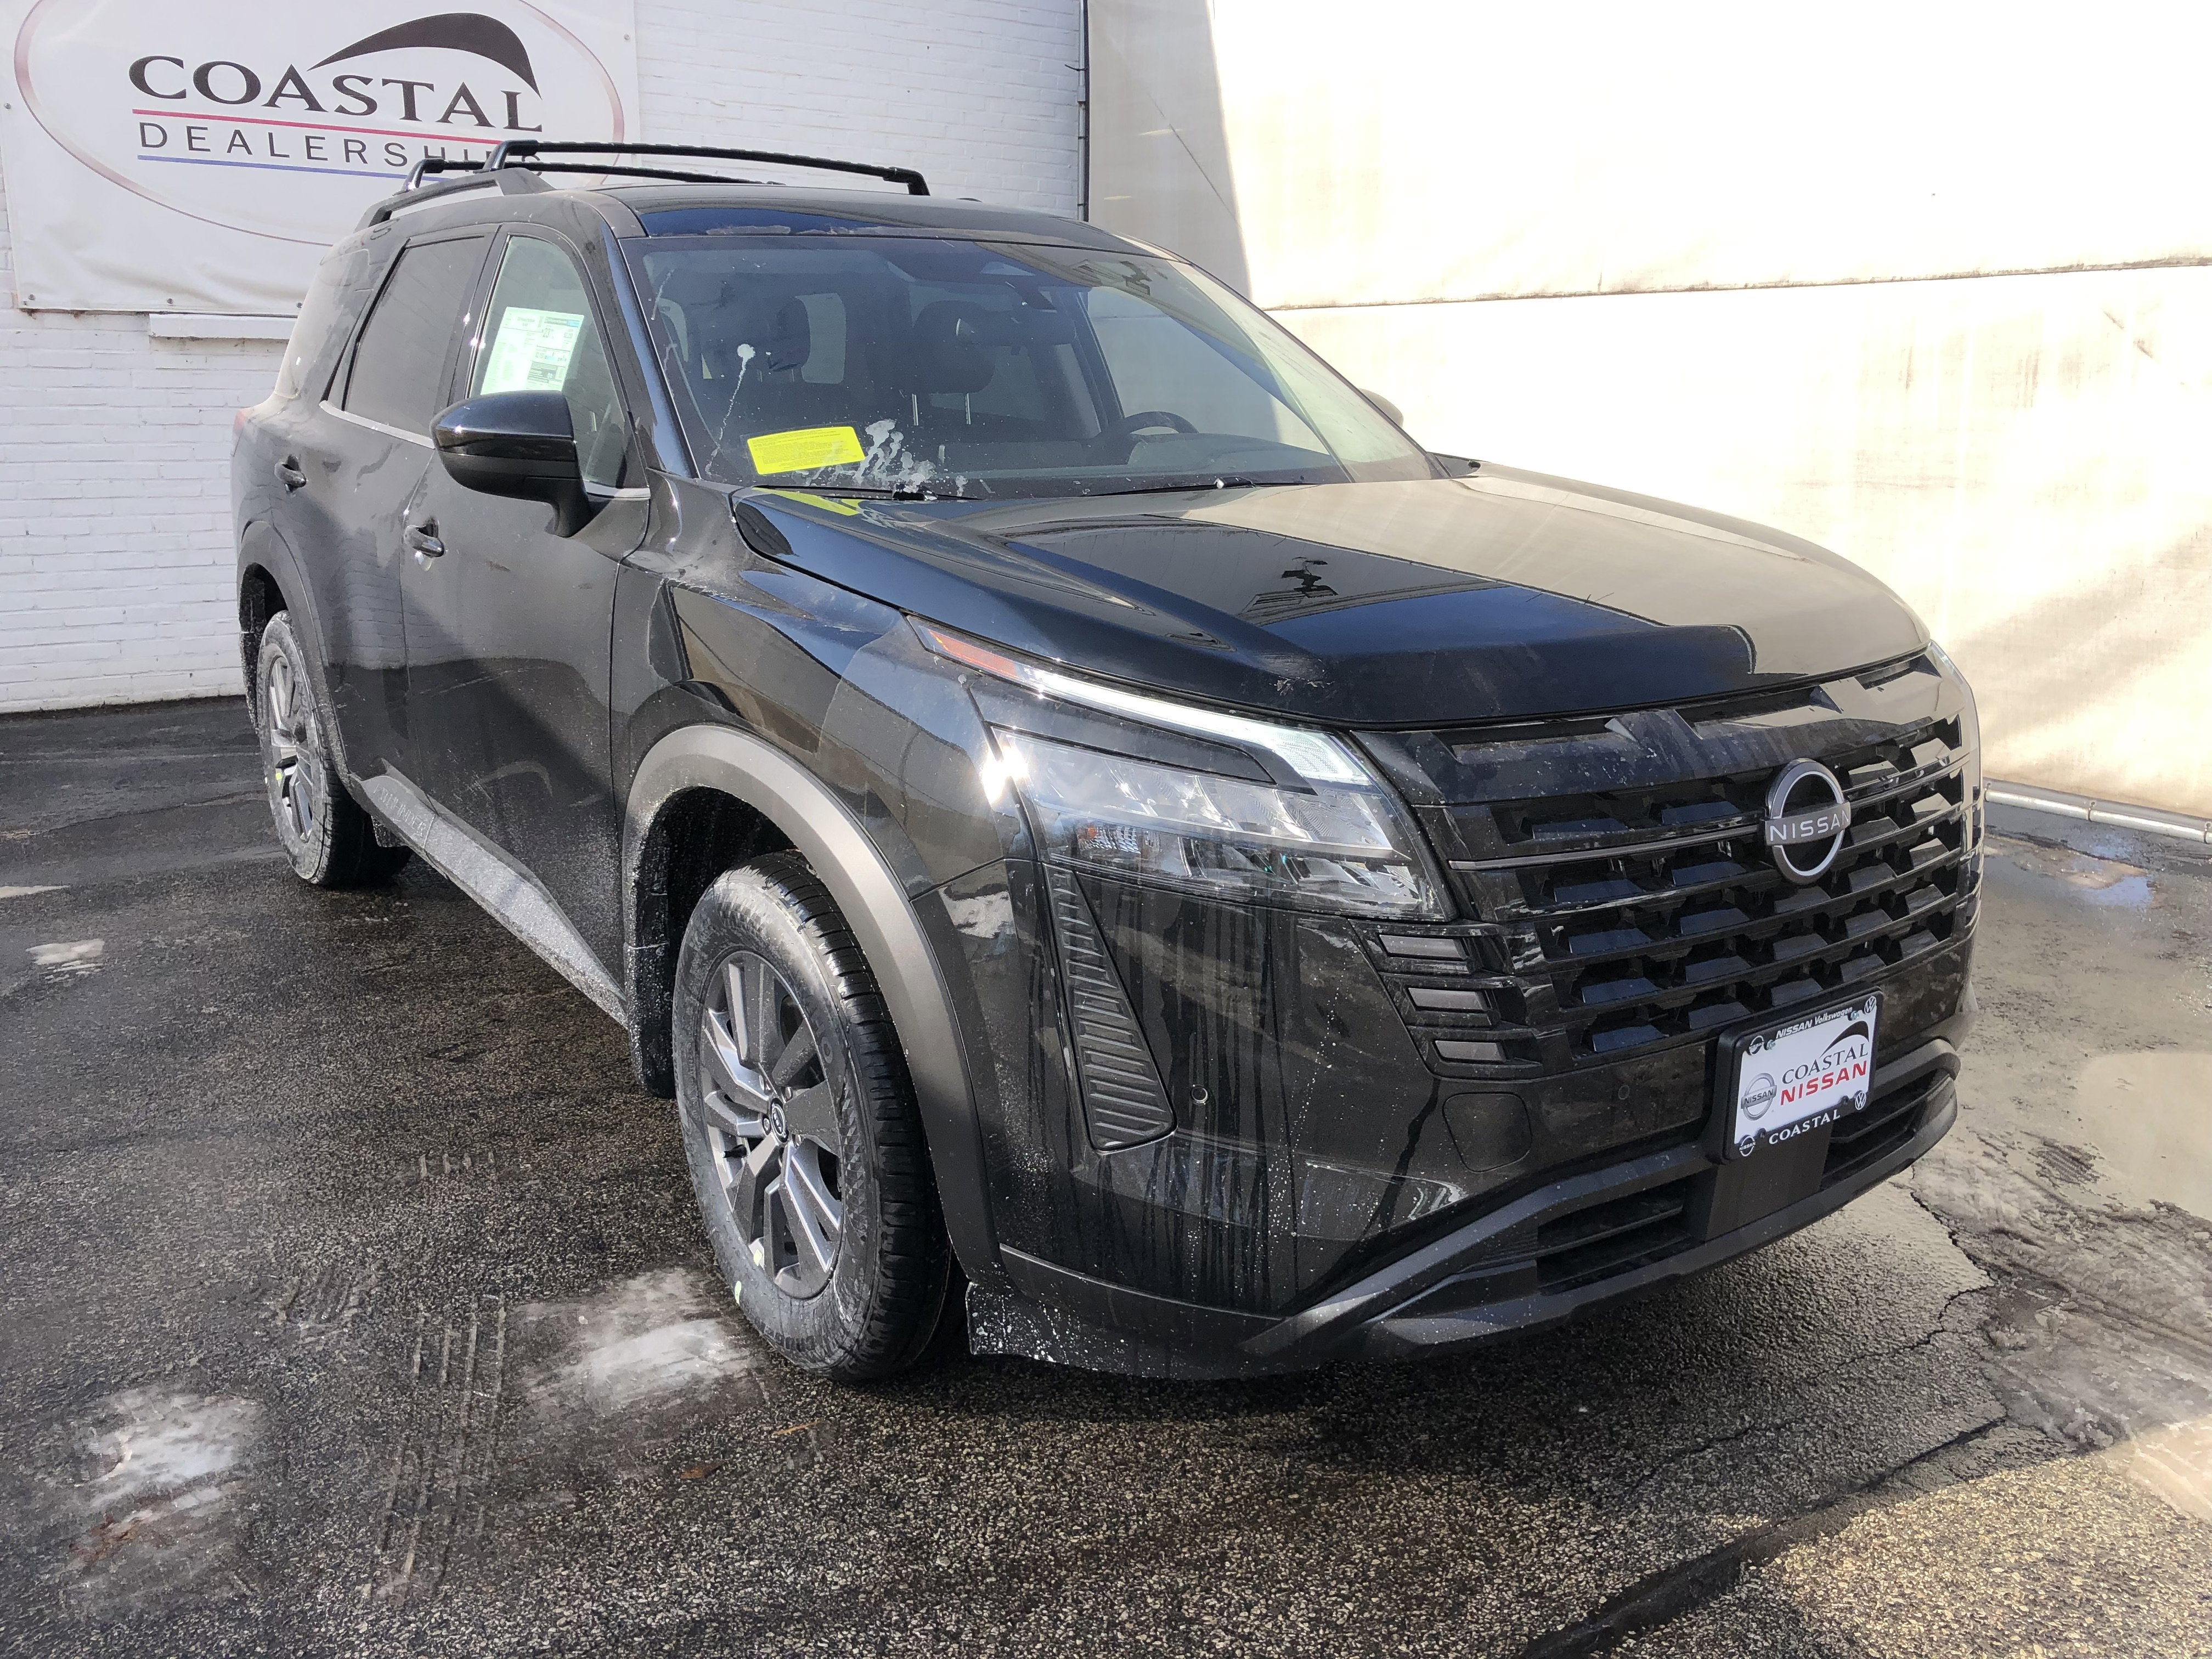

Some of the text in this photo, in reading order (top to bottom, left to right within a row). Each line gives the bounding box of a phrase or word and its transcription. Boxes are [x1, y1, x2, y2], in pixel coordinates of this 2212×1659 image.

[129, 55, 543, 132] COASTAL
[139, 122, 543, 177] DEALERSHI
[1770, 810, 1849, 842] NISSAN
[1776, 1007, 1853, 1039] NISSAN Volkswagen
[1780, 1060, 1867, 1105] NISSAN
[1782, 1043, 1869, 1084] COASTAL
[1744, 1088, 1774, 1105] NISSAN
[1769, 1109, 1841, 1144] COASTAL
